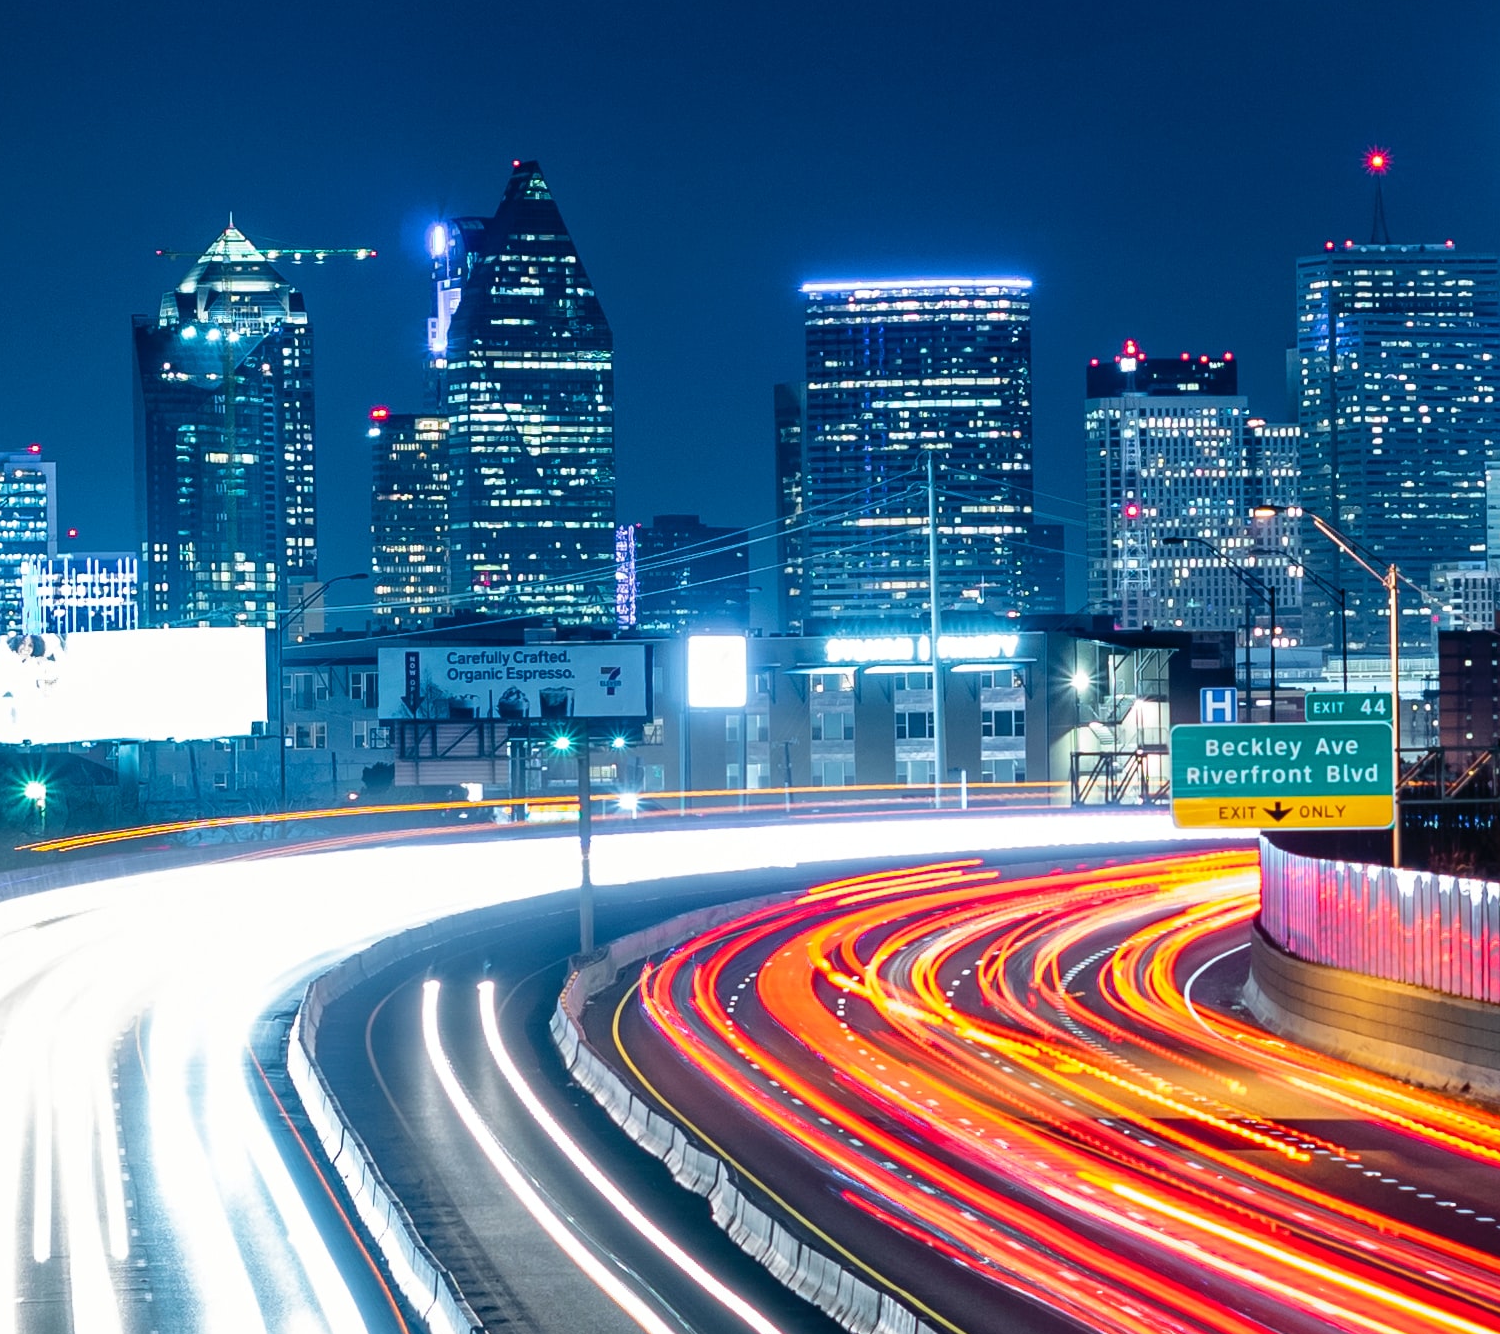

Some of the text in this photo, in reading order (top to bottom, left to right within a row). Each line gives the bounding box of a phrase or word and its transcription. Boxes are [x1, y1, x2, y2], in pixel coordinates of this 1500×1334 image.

[447, 650, 571, 666] Carefully Crafted.
[447, 667, 575, 684] Organic Espresso.
[1206, 690, 1232, 722] H
[1313, 698, 1387, 715] EXIT 44
[1205, 738, 1359, 760] Beckley Ave
[1186, 764, 1378, 784] Riverfront Blvd
[1219, 805, 1347, 819] EXIT ONLY
